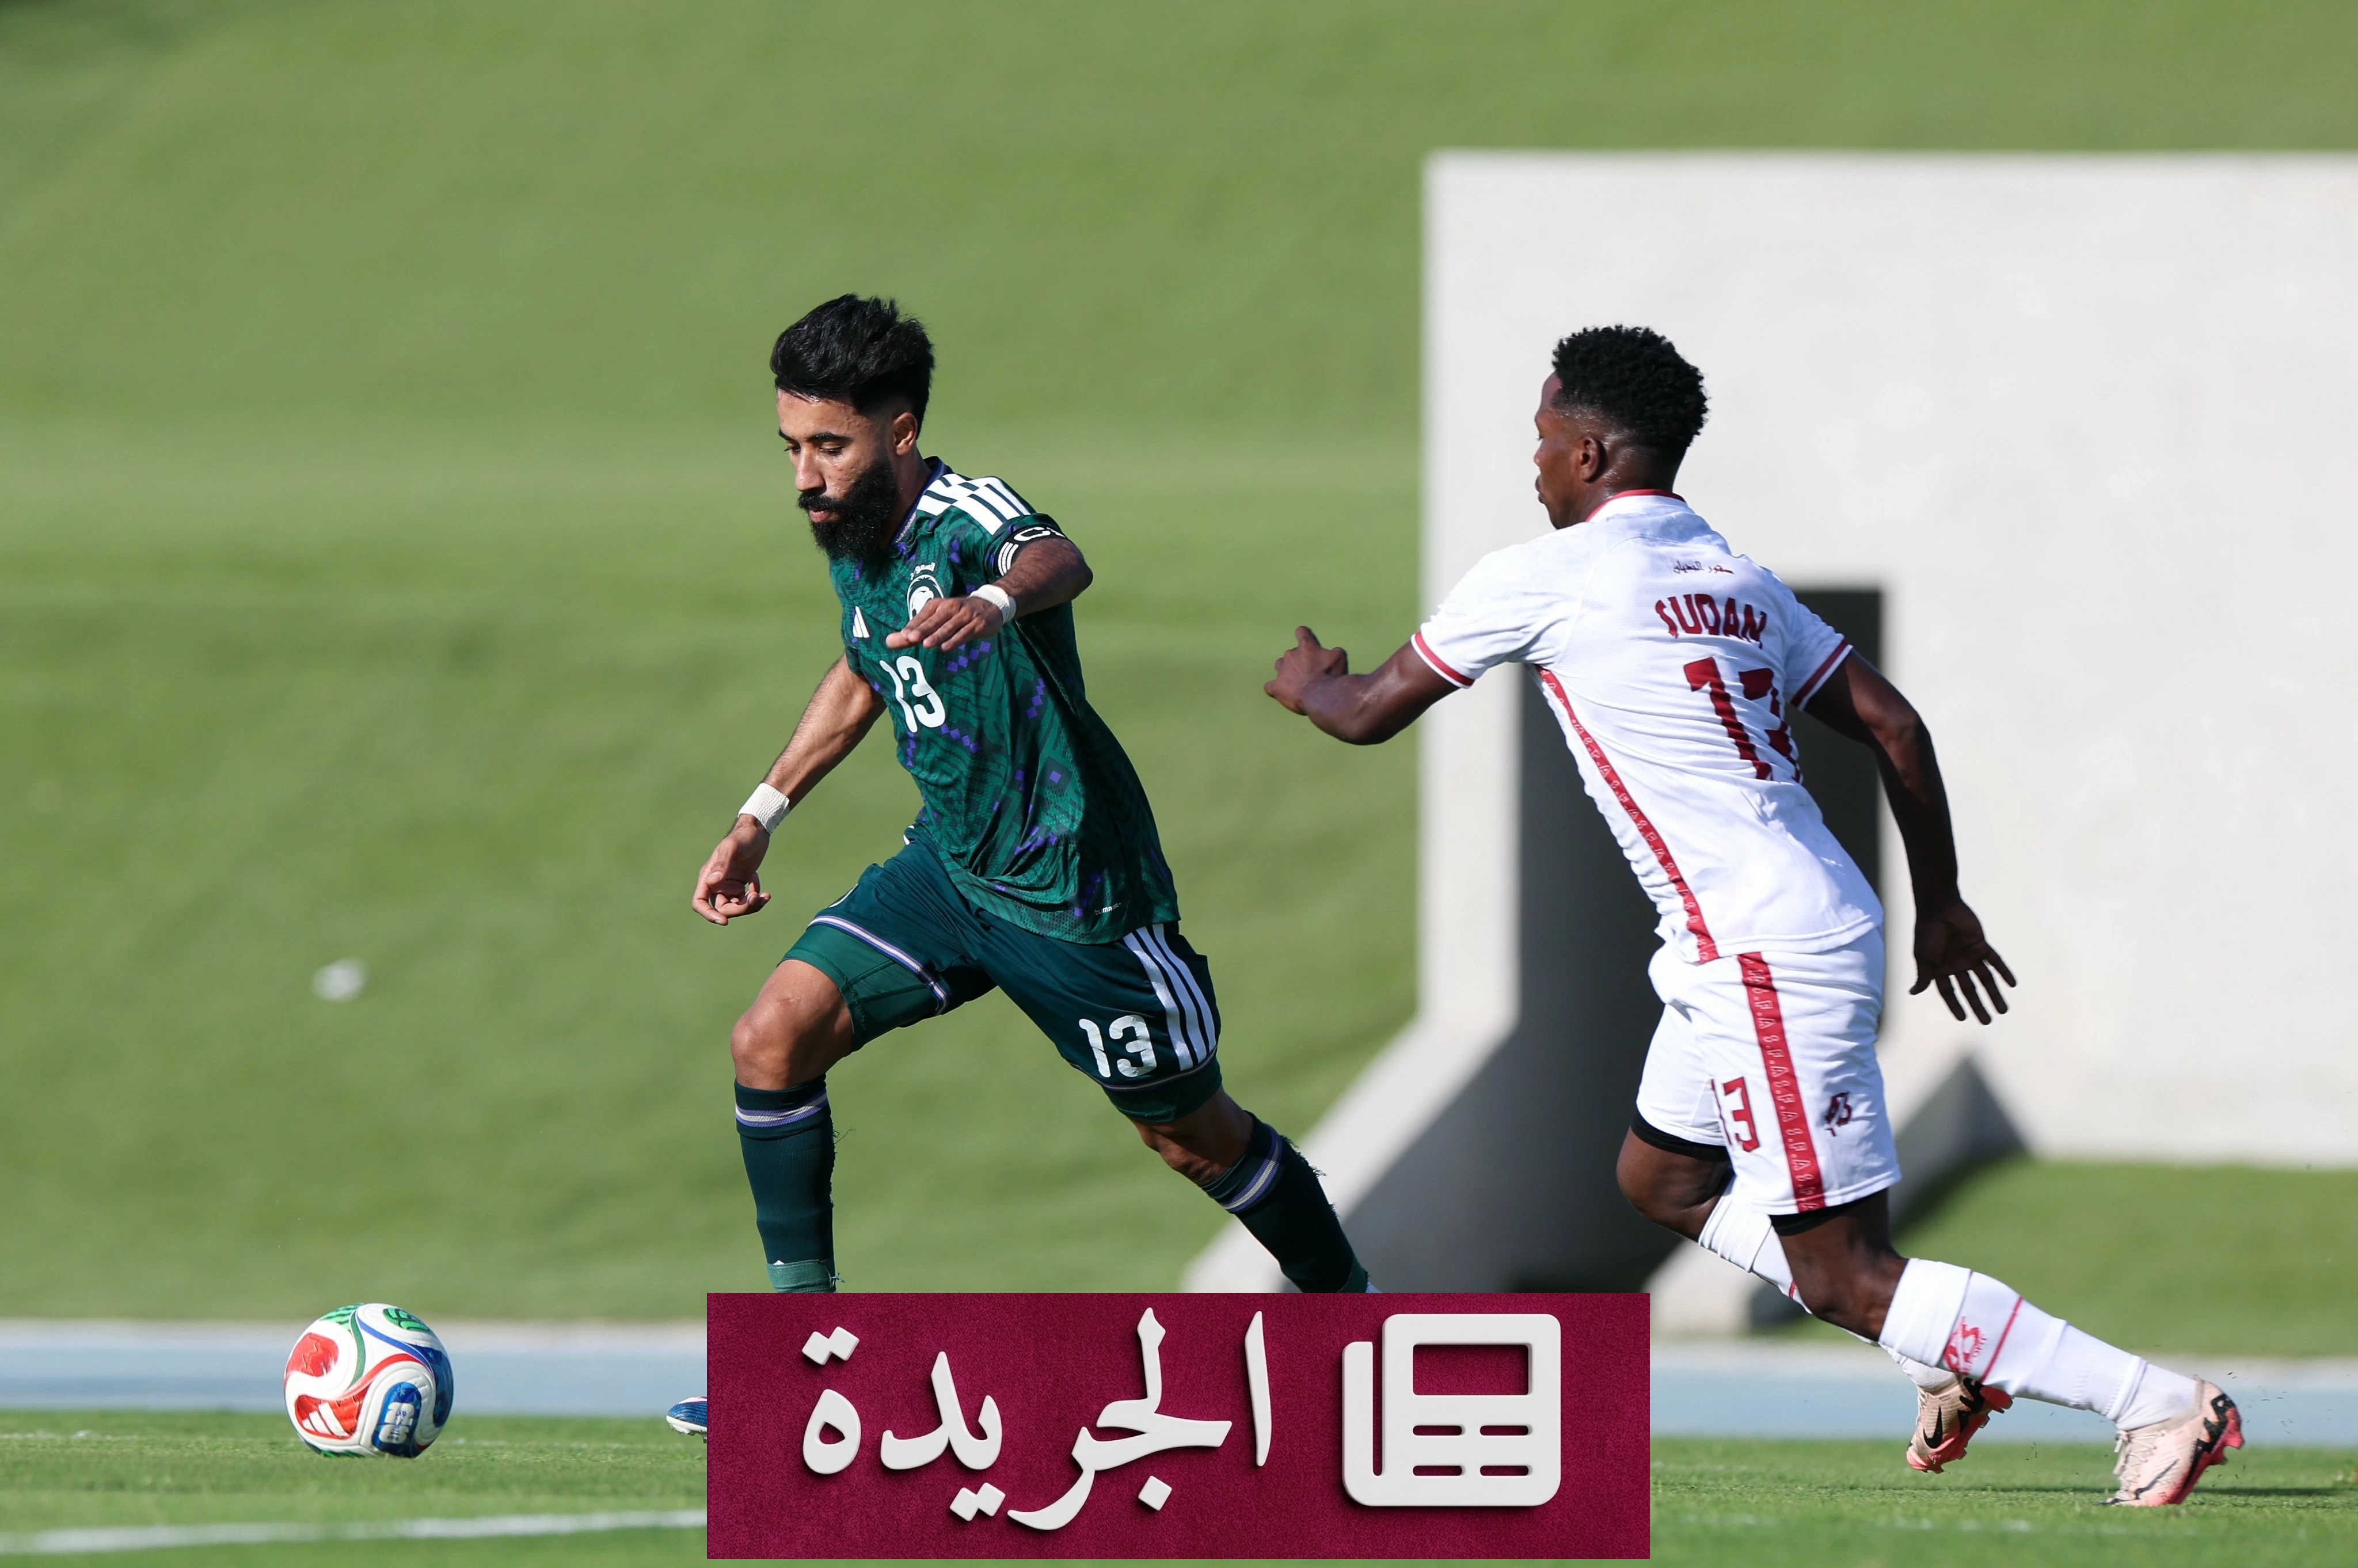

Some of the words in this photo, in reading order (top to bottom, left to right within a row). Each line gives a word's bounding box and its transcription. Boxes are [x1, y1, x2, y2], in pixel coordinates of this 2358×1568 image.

[1655, 593, 1767, 649] SUDAN
[879, 656, 946, 733] 13
[1079, 1014, 1157, 1078] 13
